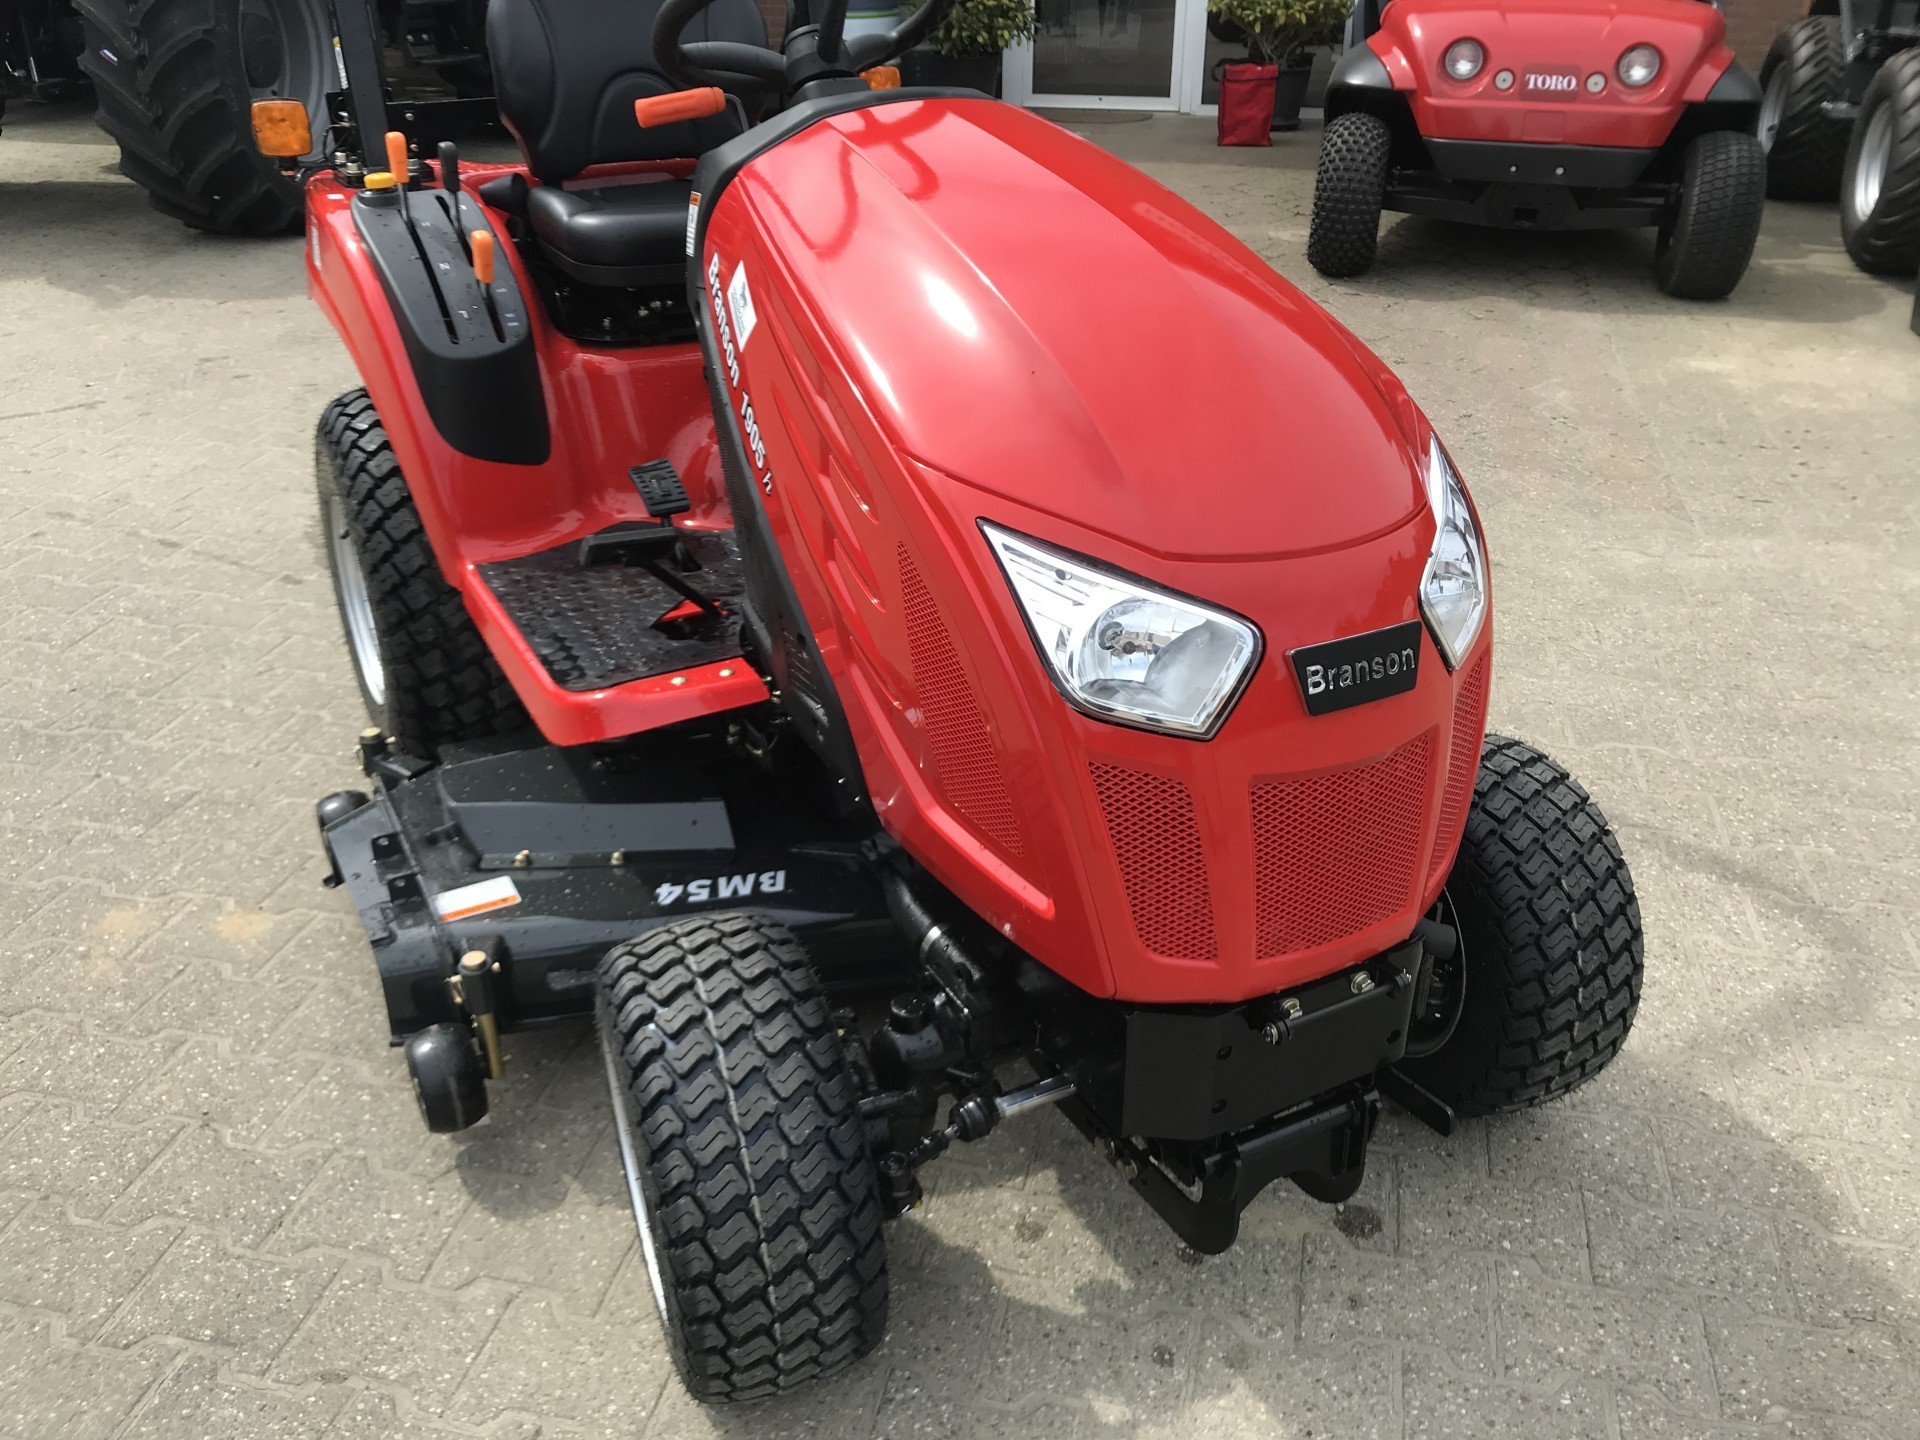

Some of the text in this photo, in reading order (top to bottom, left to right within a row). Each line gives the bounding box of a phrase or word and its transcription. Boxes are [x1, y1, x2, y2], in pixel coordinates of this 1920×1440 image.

[1525, 73, 1577, 91] TORO
[709, 251, 739, 388] Branson
[741, 391, 766, 469] 1905
[1306, 647, 1416, 695] Branson
[655, 869, 786, 906] BM54
